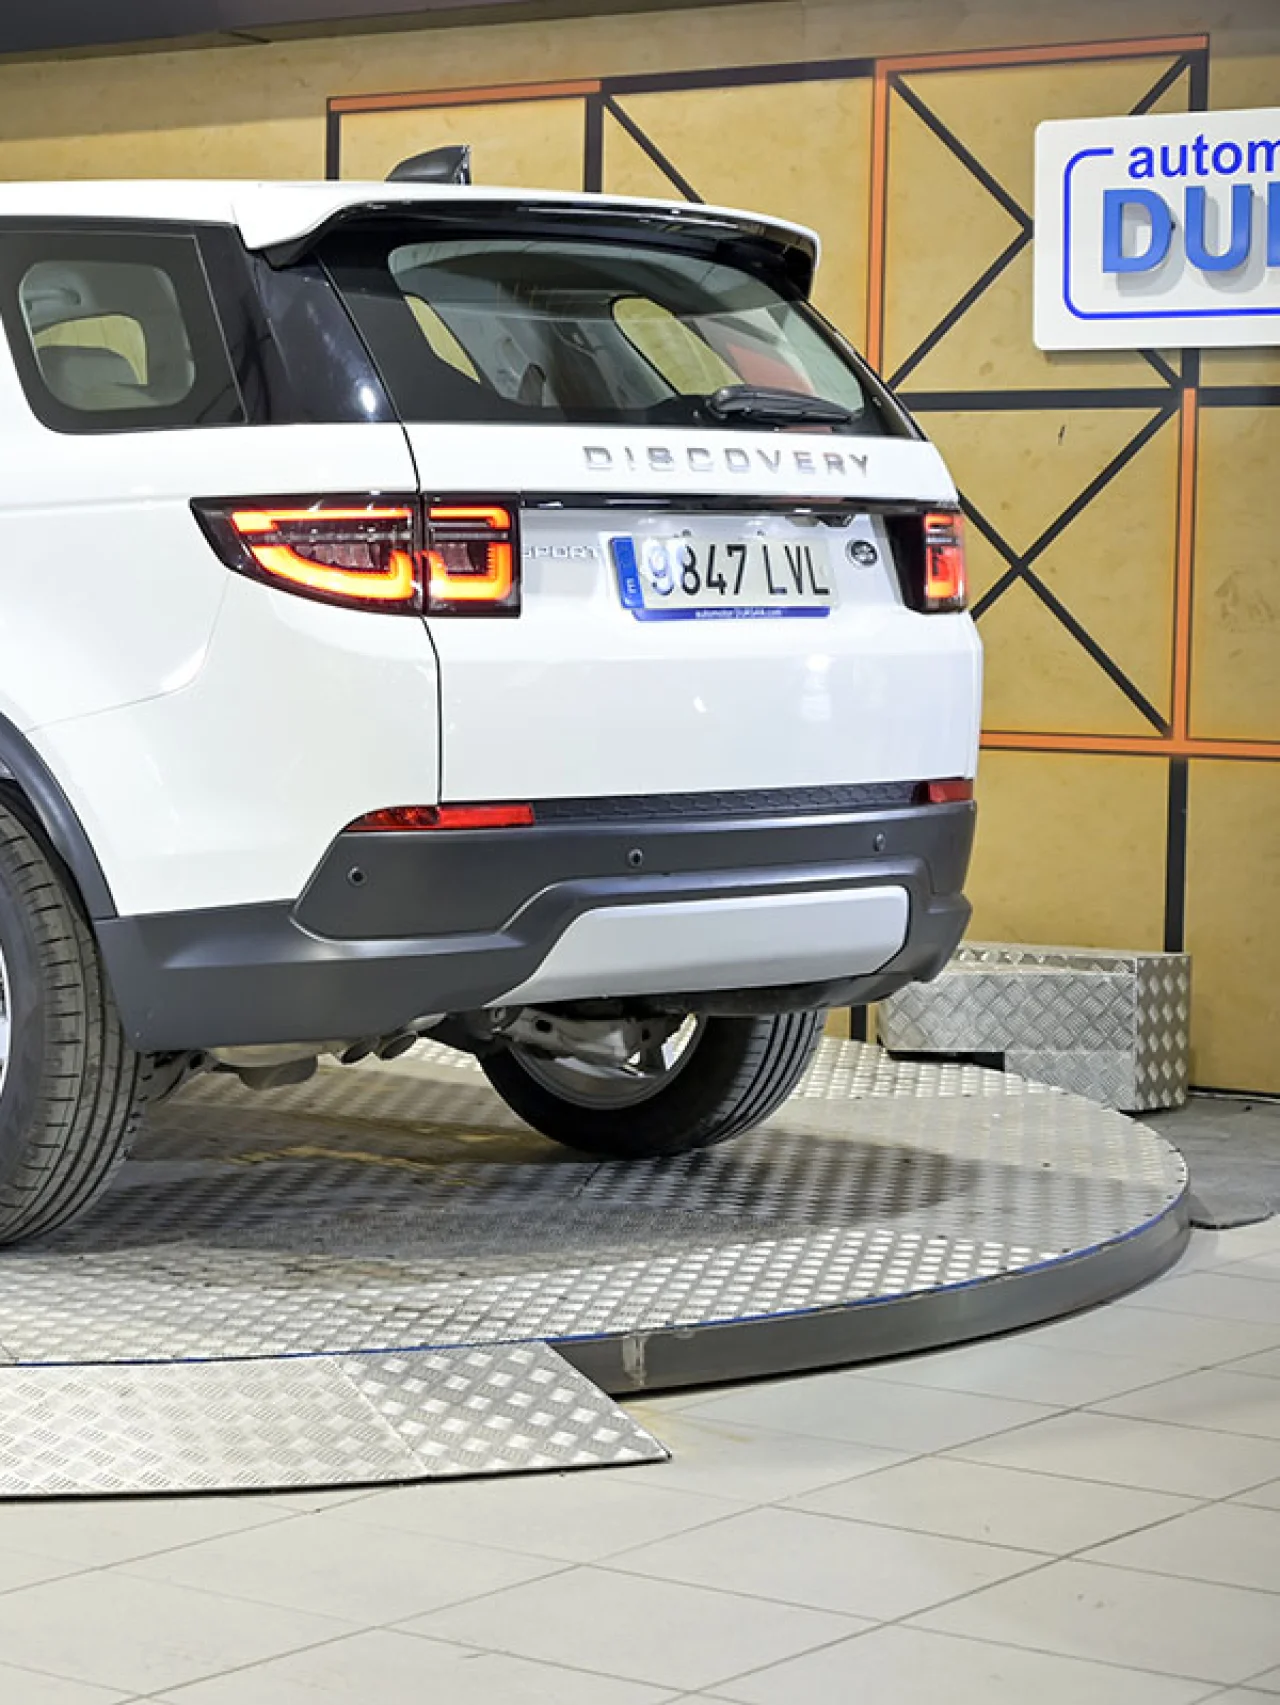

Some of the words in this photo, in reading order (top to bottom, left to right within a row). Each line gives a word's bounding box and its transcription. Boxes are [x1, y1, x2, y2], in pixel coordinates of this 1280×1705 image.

[1102, 180, 1280, 274] DU
[582, 445, 869, 477] DISCOVERY
[647, 543, 748, 597] 9847
[763, 543, 830, 597] LVL
